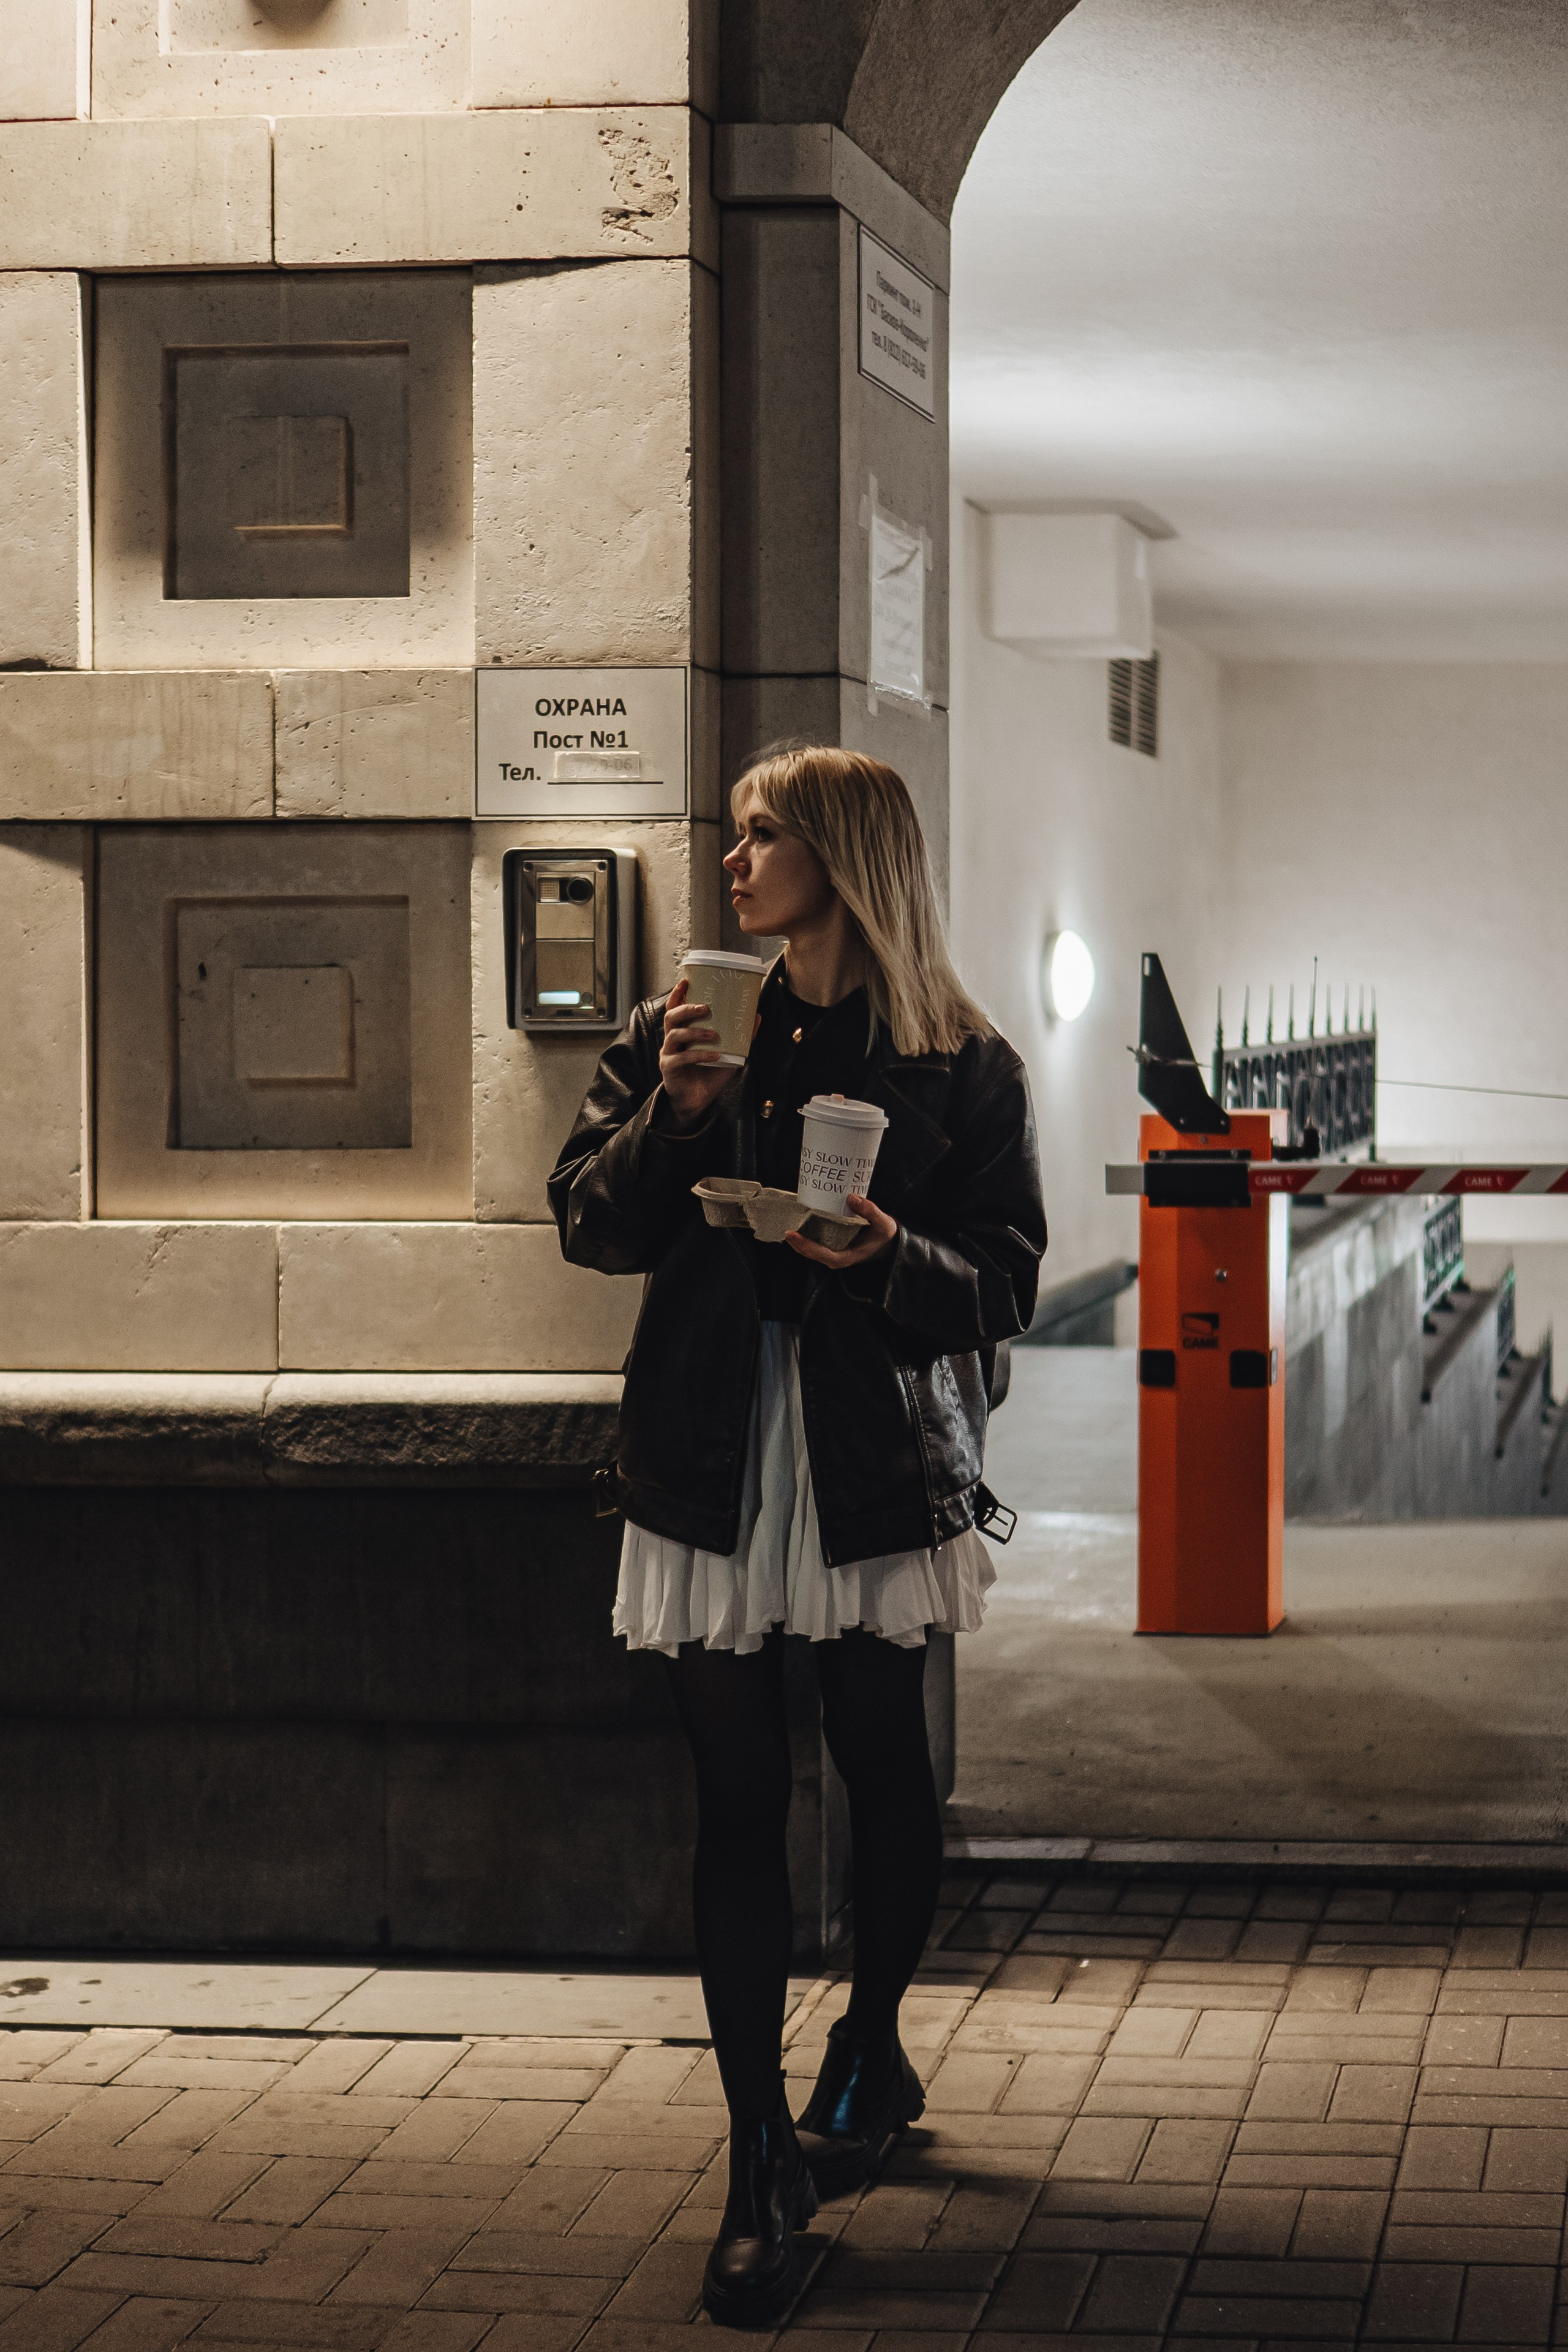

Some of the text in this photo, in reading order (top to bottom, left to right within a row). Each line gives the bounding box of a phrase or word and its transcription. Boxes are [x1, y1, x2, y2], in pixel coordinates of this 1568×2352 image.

[535, 698, 627, 717] ОХРАНА
[533, 730, 628, 748] Пост №1
[498, 763, 541, 781] Тел.
[815, 1152, 852, 1167] SLOW
[800, 1159, 847, 1182] COFFEE
[812, 1178, 845, 1194] SLOW
[1255, 1175, 1283, 1186] CAME
[1360, 1175, 1388, 1186] CAME
[1464, 1175, 1493, 1187] CAME
